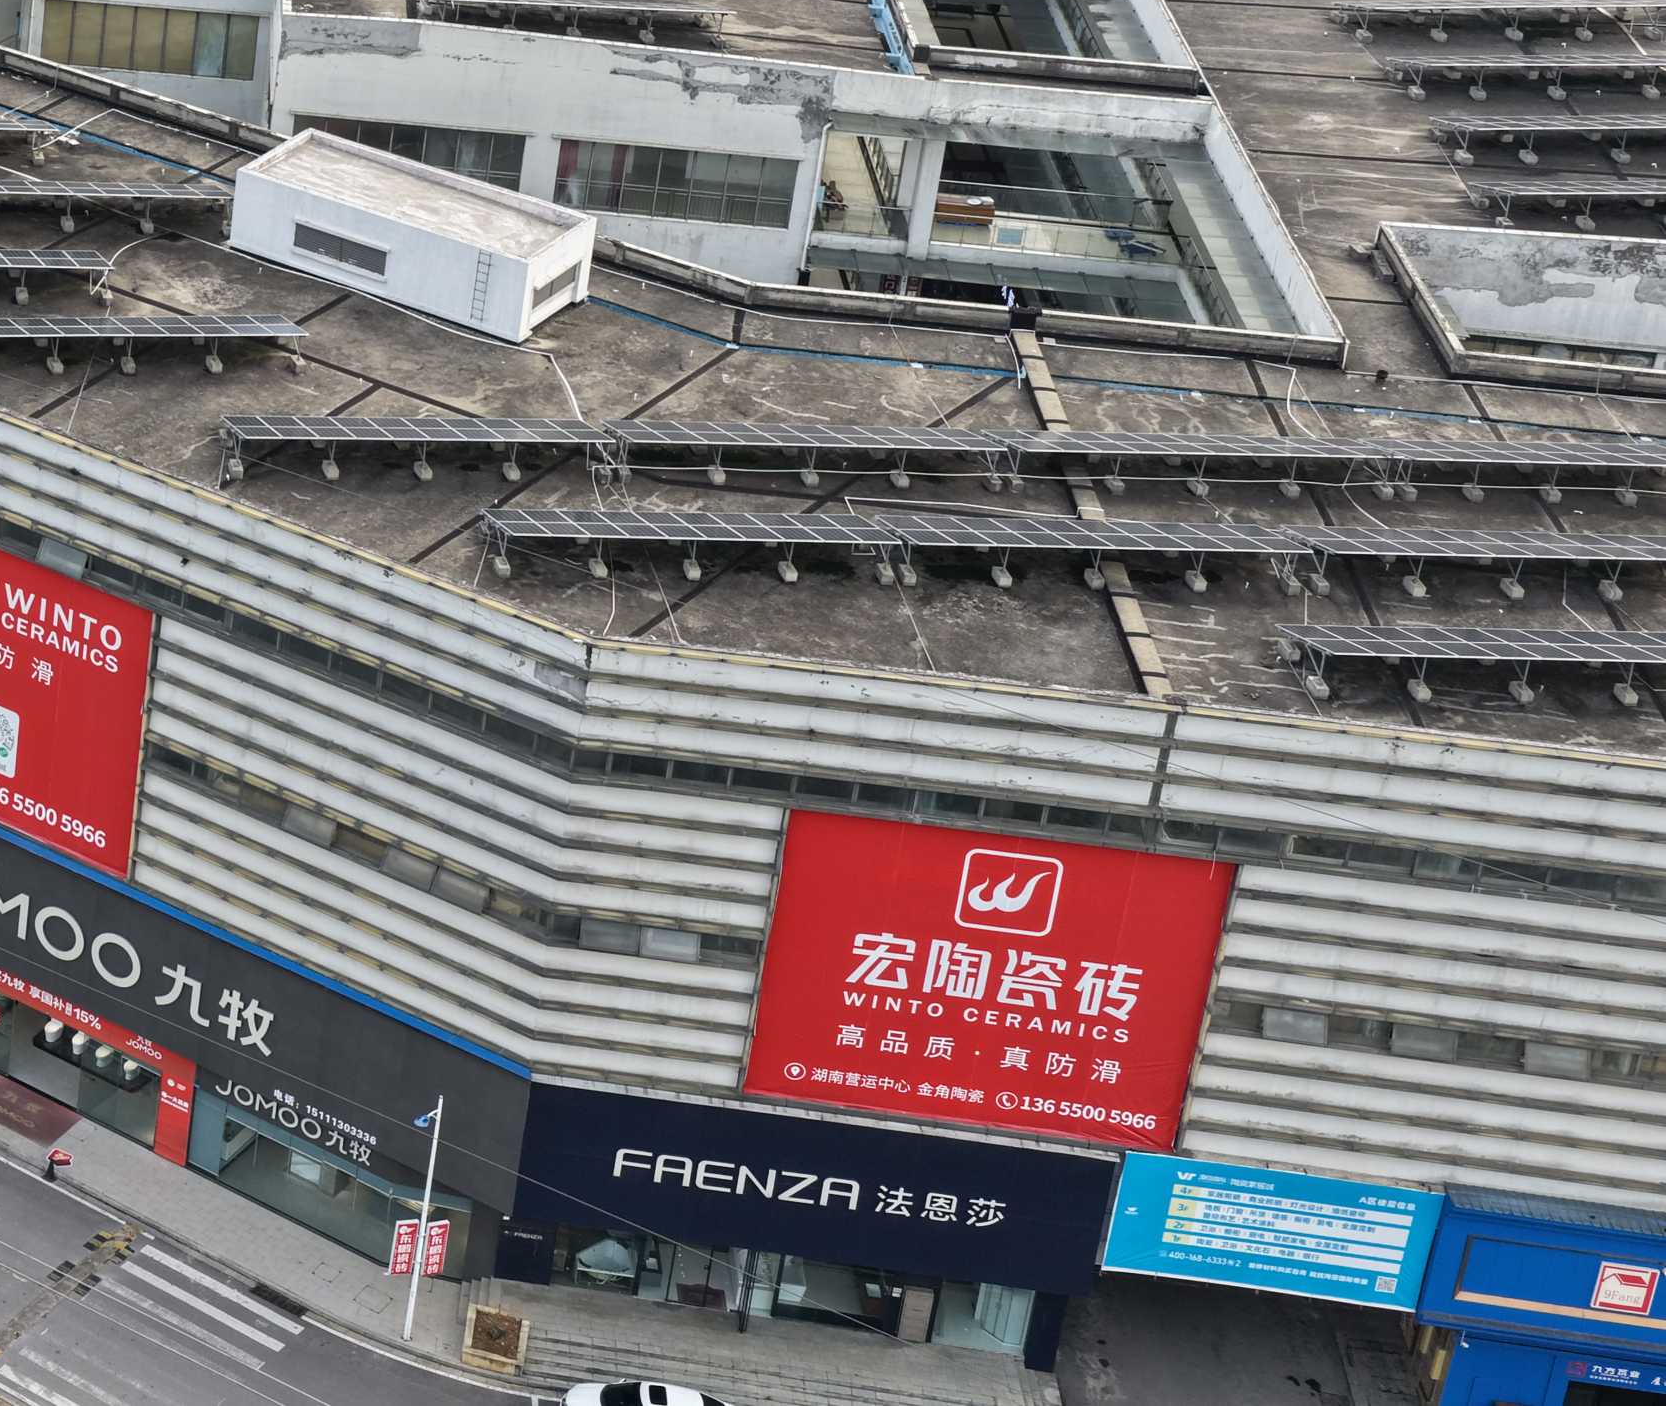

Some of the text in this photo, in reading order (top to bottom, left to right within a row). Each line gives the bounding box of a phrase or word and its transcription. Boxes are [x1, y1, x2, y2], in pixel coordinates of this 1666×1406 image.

[0, 612, 120, 673] CERAMICS
[4, 583, 123, 652] WINTO
[11, 791, 58, 827] 5500
[60, 811, 106, 849] 5966
[845, 932, 1144, 1023] 宏陶瓷砖
[73, 1005, 102, 1031] 15%
[155, 964, 275, 1057] 九牧
[843, 990, 1131, 1044] WINTO CERAMICS
[125, 1039, 163, 1060] JOMOO
[215, 1079, 372, 1167] JOMOO 九牧
[810, 1066, 1157, 1131] 湖南营运中心 金角陶瓷 136 5500 5966
[612, 1148, 1008, 1229] FAENZA 法恩莎
[1604, 1289, 1642, 1307] 9Fang
